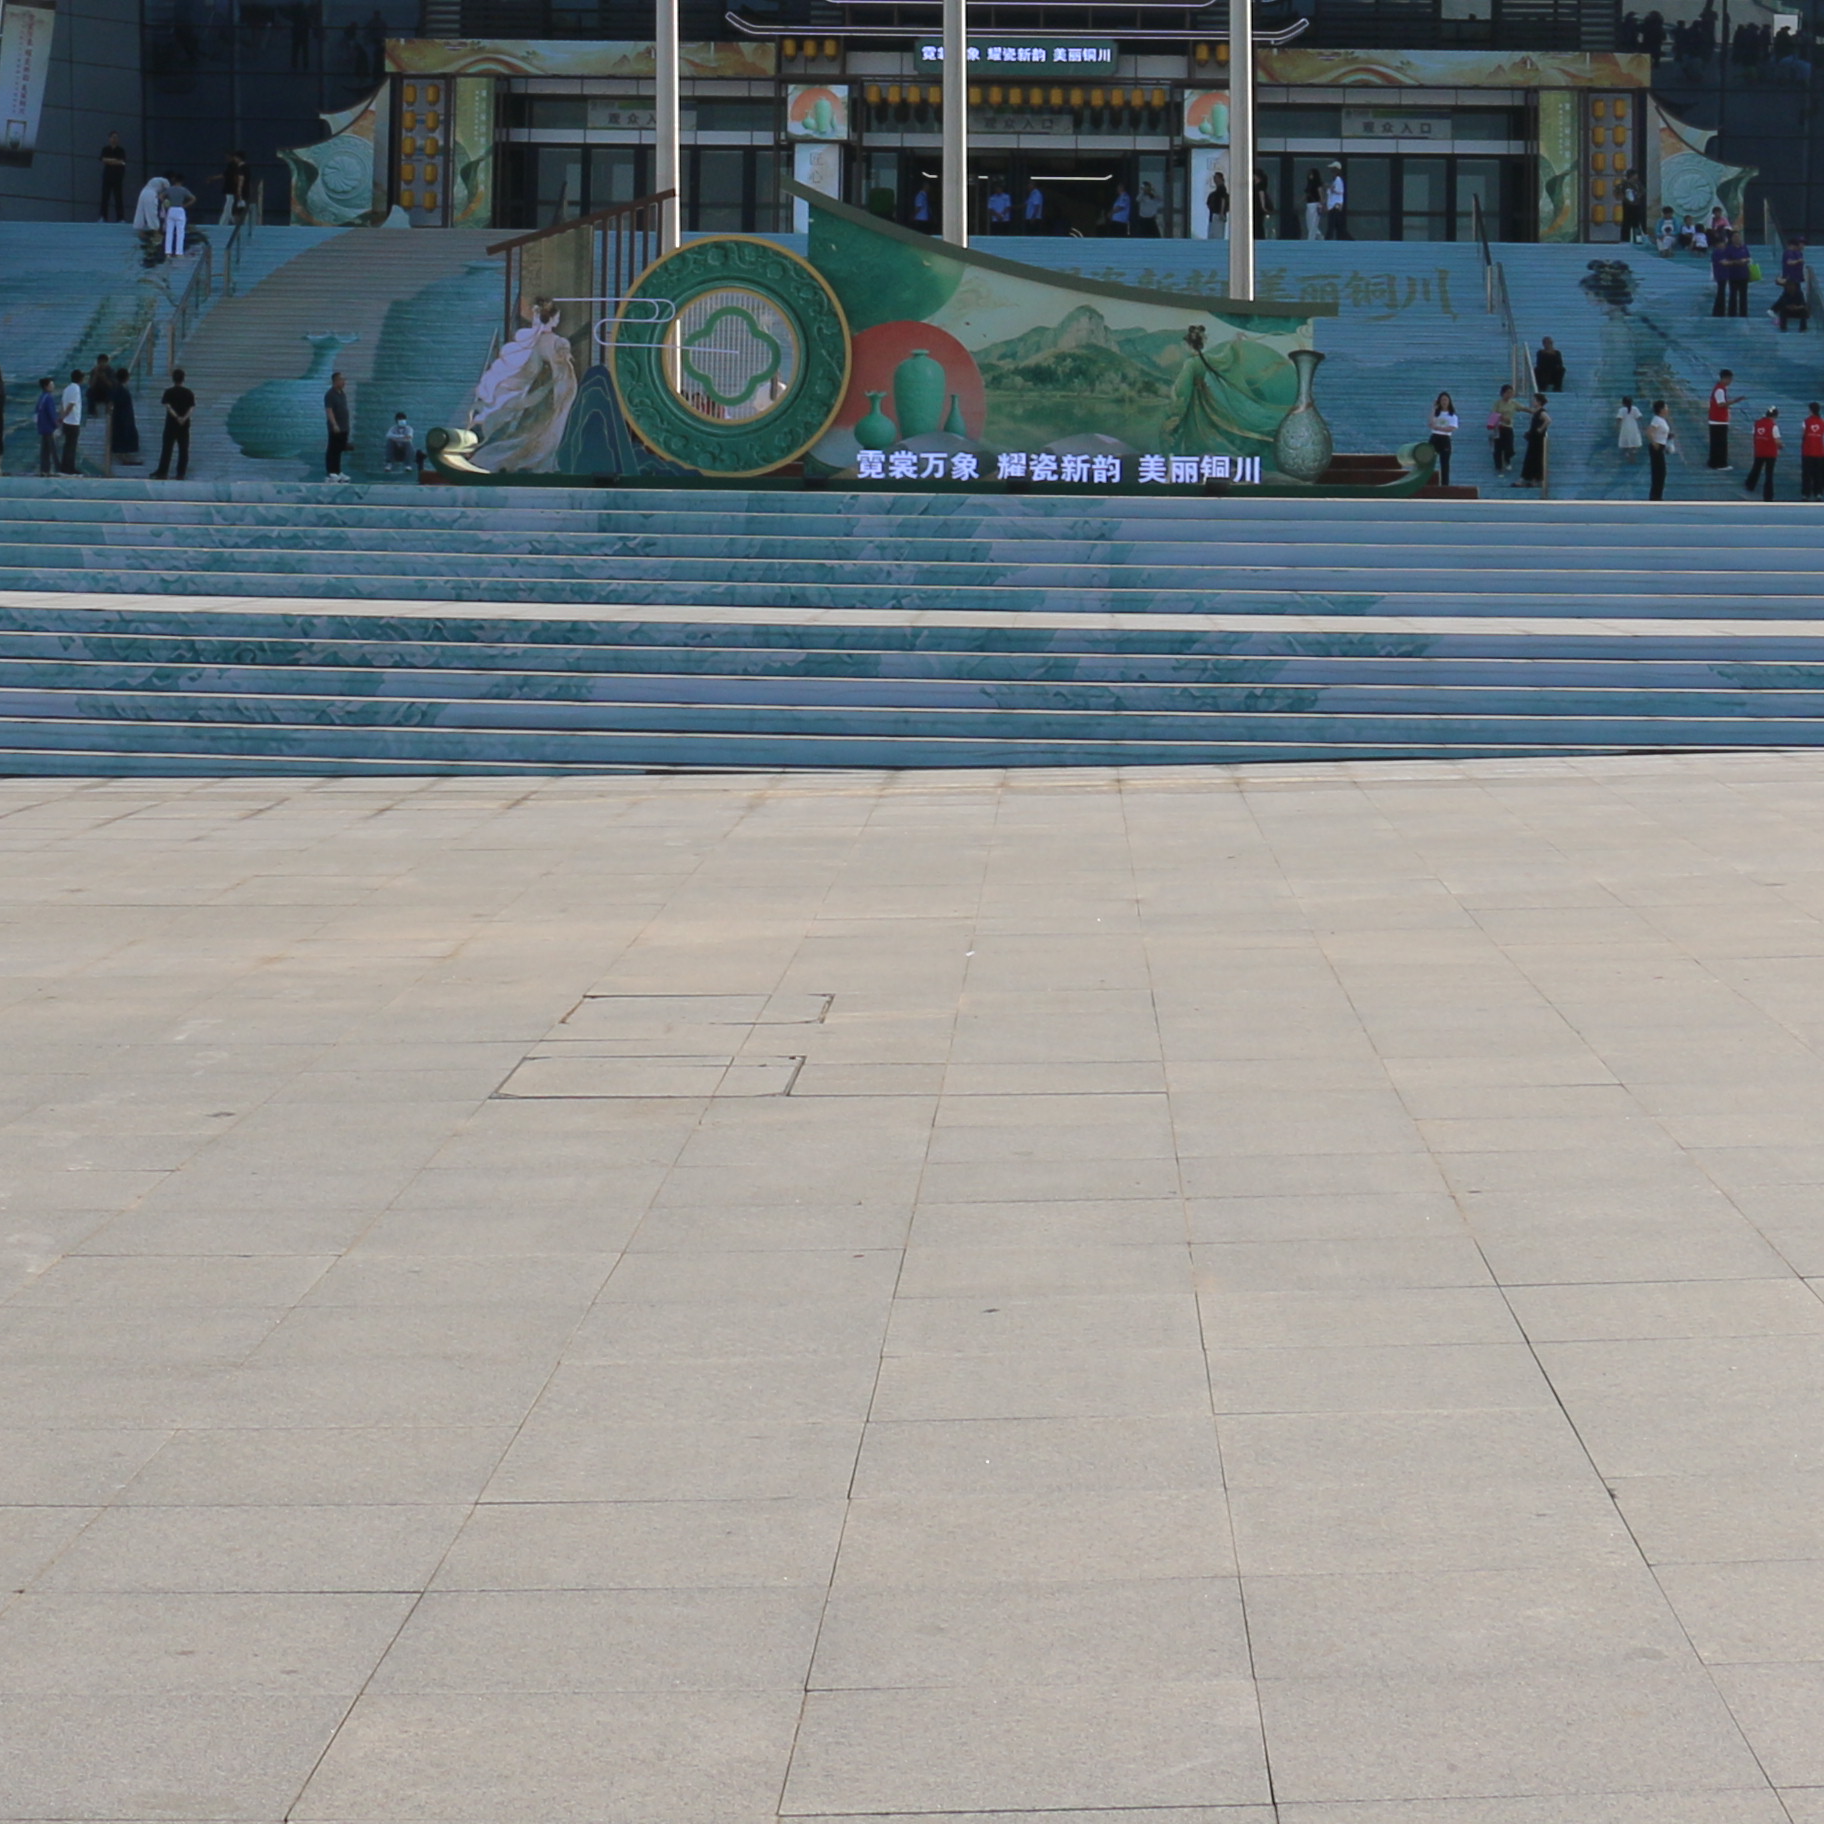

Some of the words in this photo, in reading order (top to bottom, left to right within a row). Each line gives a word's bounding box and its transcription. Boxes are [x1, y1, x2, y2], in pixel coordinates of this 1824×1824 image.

[987, 46, 1046, 63] 耀瓷新韵
[1053, 47, 1112, 63] 美丽铜川
[856, 449, 980, 482] 霓裳万象
[997, 452, 1121, 484] 耀瓷新韵
[1138, 454, 1262, 484] 美丽铜川
